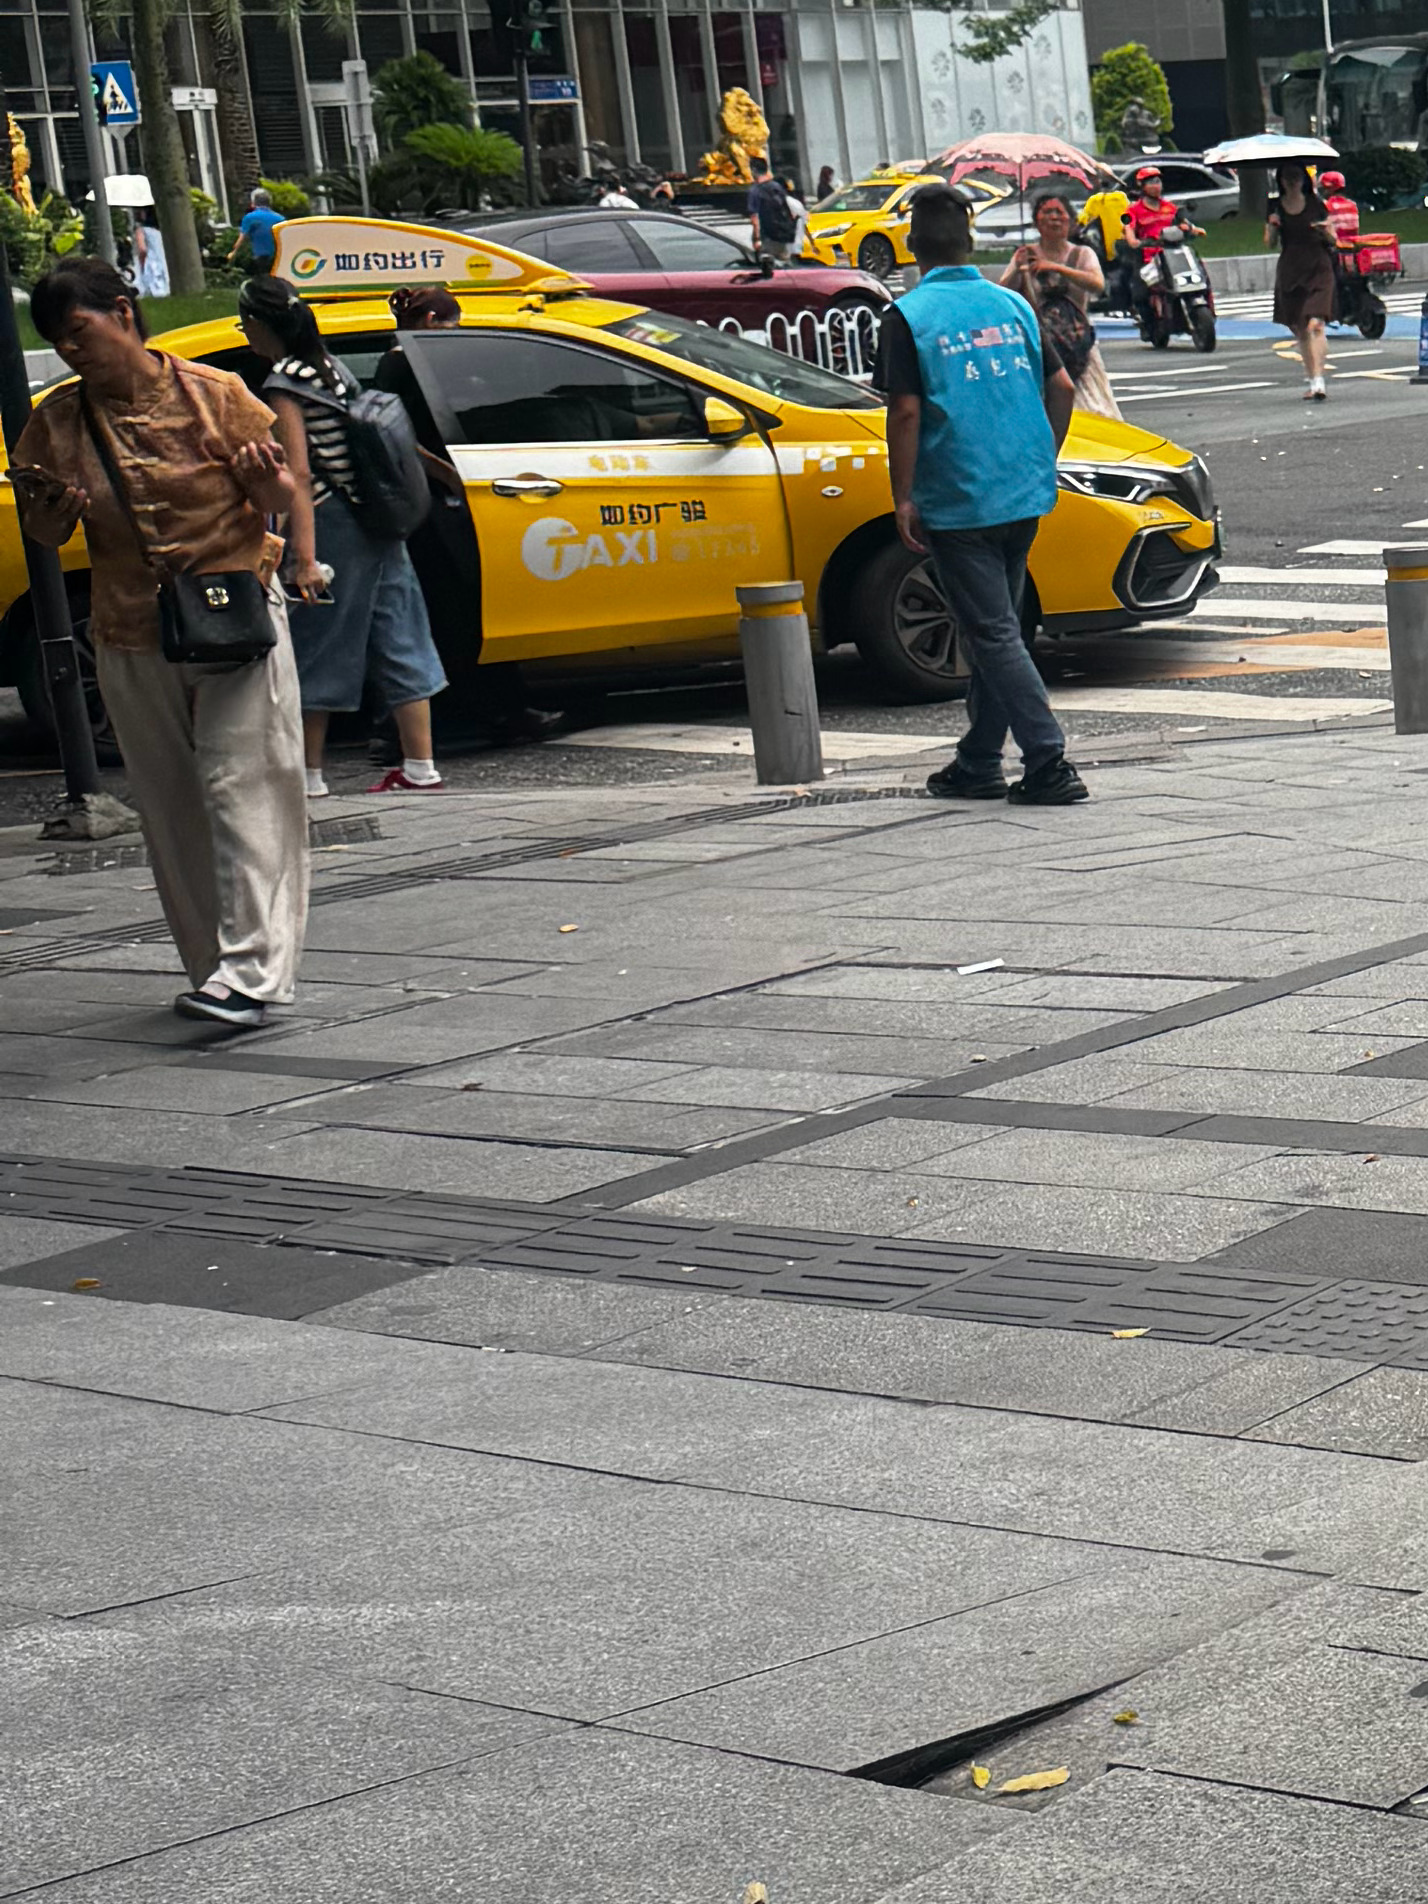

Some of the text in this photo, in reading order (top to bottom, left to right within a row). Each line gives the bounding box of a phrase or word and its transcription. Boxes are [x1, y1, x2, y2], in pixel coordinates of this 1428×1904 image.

[334, 249, 446, 272] 如约出行
[599, 499, 708, 526] 如约广骏
[521, 516, 658, 582] TAXI
